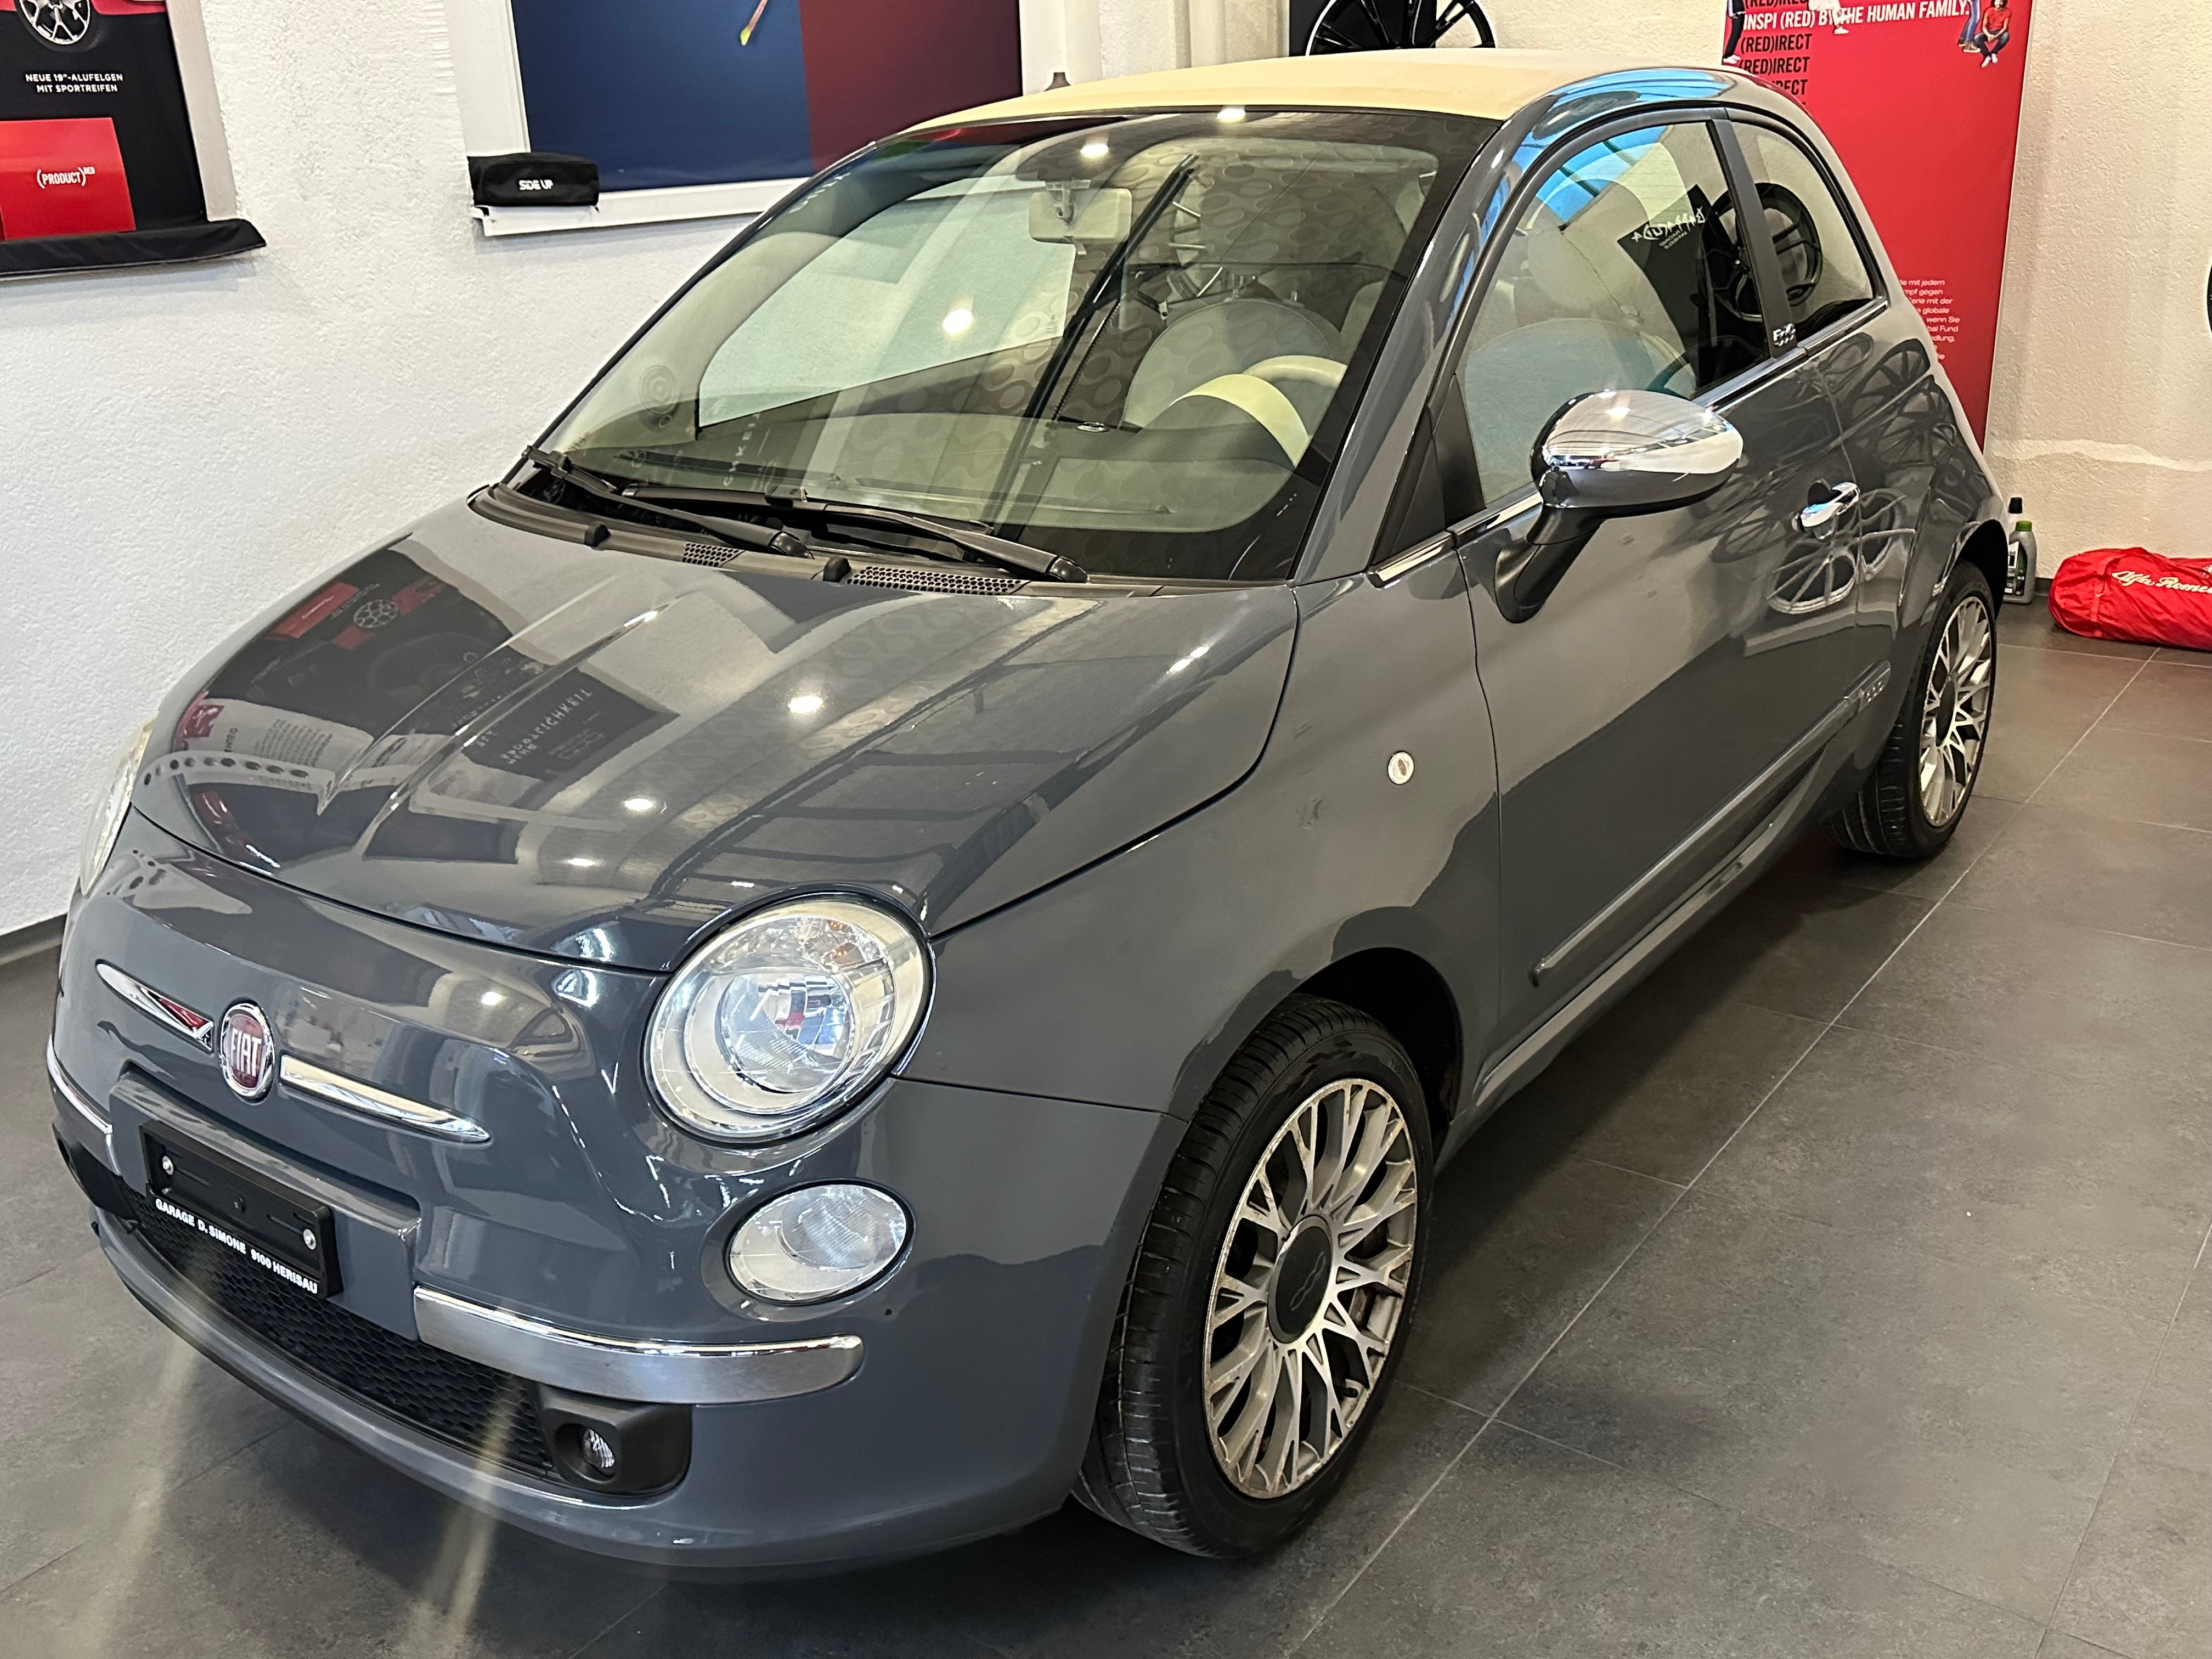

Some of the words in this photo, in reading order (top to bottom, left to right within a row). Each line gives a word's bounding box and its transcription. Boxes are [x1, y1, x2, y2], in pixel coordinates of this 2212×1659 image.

[1867, 2, 1915, 22] HUMAN
[1918, 0, 1970, 19] FAMILY.
[1741, 33, 1812, 54] (RED)IRECT
[25, 74, 52, 82] NEUE
[53, 74, 123, 82] 19"-ALUFELGEN
[37, 84, 53, 93] MIT
[55, 84, 117, 93] SPORTREIFEN
[1921, 279, 1945, 287] jedem
[1922, 307, 1950, 315] globale
[2112, 571, 2155, 586] Alfa
[230, 1026, 263, 1077] FIAT
[155, 1198, 195, 1227] GARAGE
[208, 1225, 246, 1255] SIMONE
[251, 1249, 272, 1269] 9100
[273, 1261, 318, 1294] HERISAU
